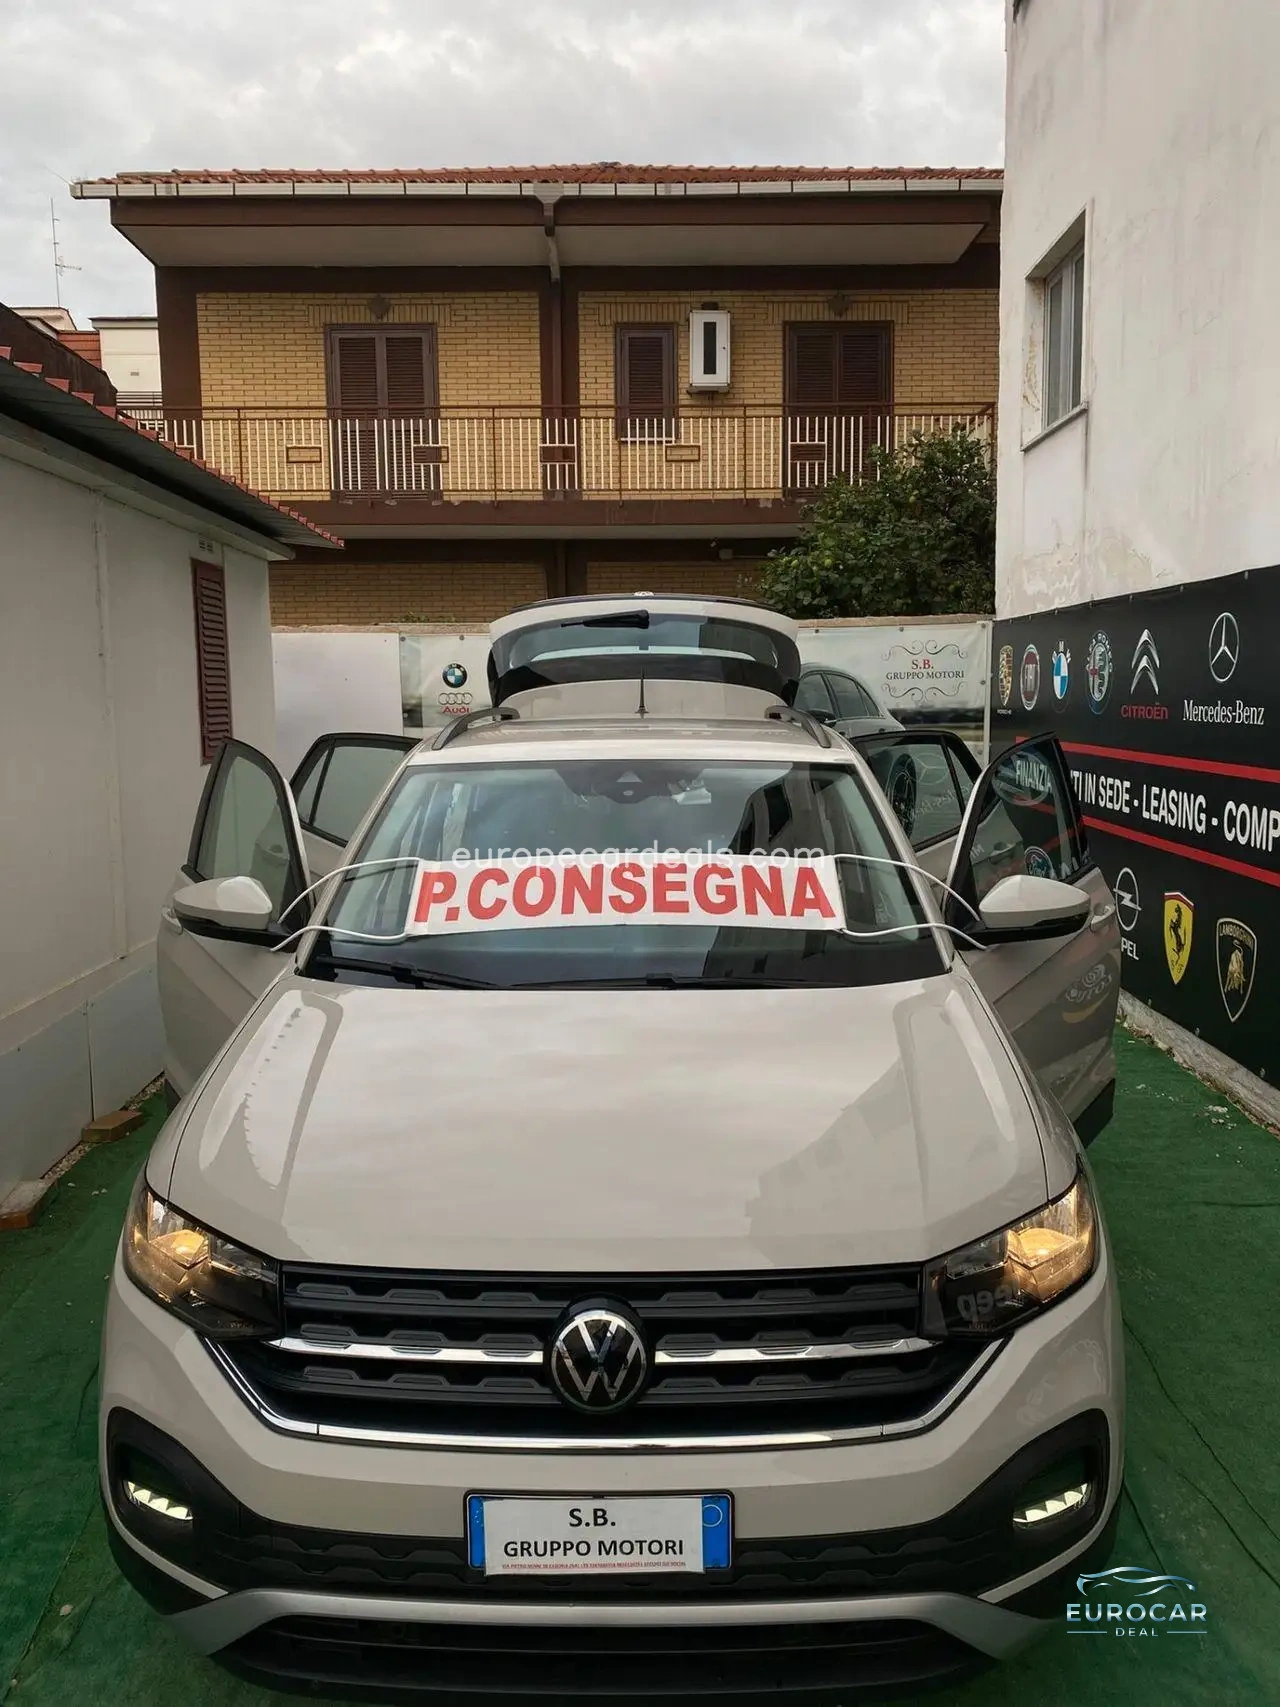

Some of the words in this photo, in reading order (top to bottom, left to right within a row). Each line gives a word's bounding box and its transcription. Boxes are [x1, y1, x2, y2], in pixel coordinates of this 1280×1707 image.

[885, 671, 924, 680] GRUPPO
[926, 670, 964, 680] MOTORI
[911, 659, 934, 670] S.B.
[442, 705, 470, 714] Audi
[1183, 699, 1264, 725] Mercedes-Benz
[1085, 772, 1096, 805] IN
[1098, 775, 1131, 814] SEDE
[1142, 784, 1206, 835] LEASING
[1223, 800, 1280, 852] COMP
[413, 861, 837, 923] P.CONSEGNA
[1121, 936, 1139, 960] PEL
[568, 1507, 617, 1528] S.B.
[503, 1540, 591, 1557] GRUPPO
[598, 1539, 684, 1556] MOTORI
